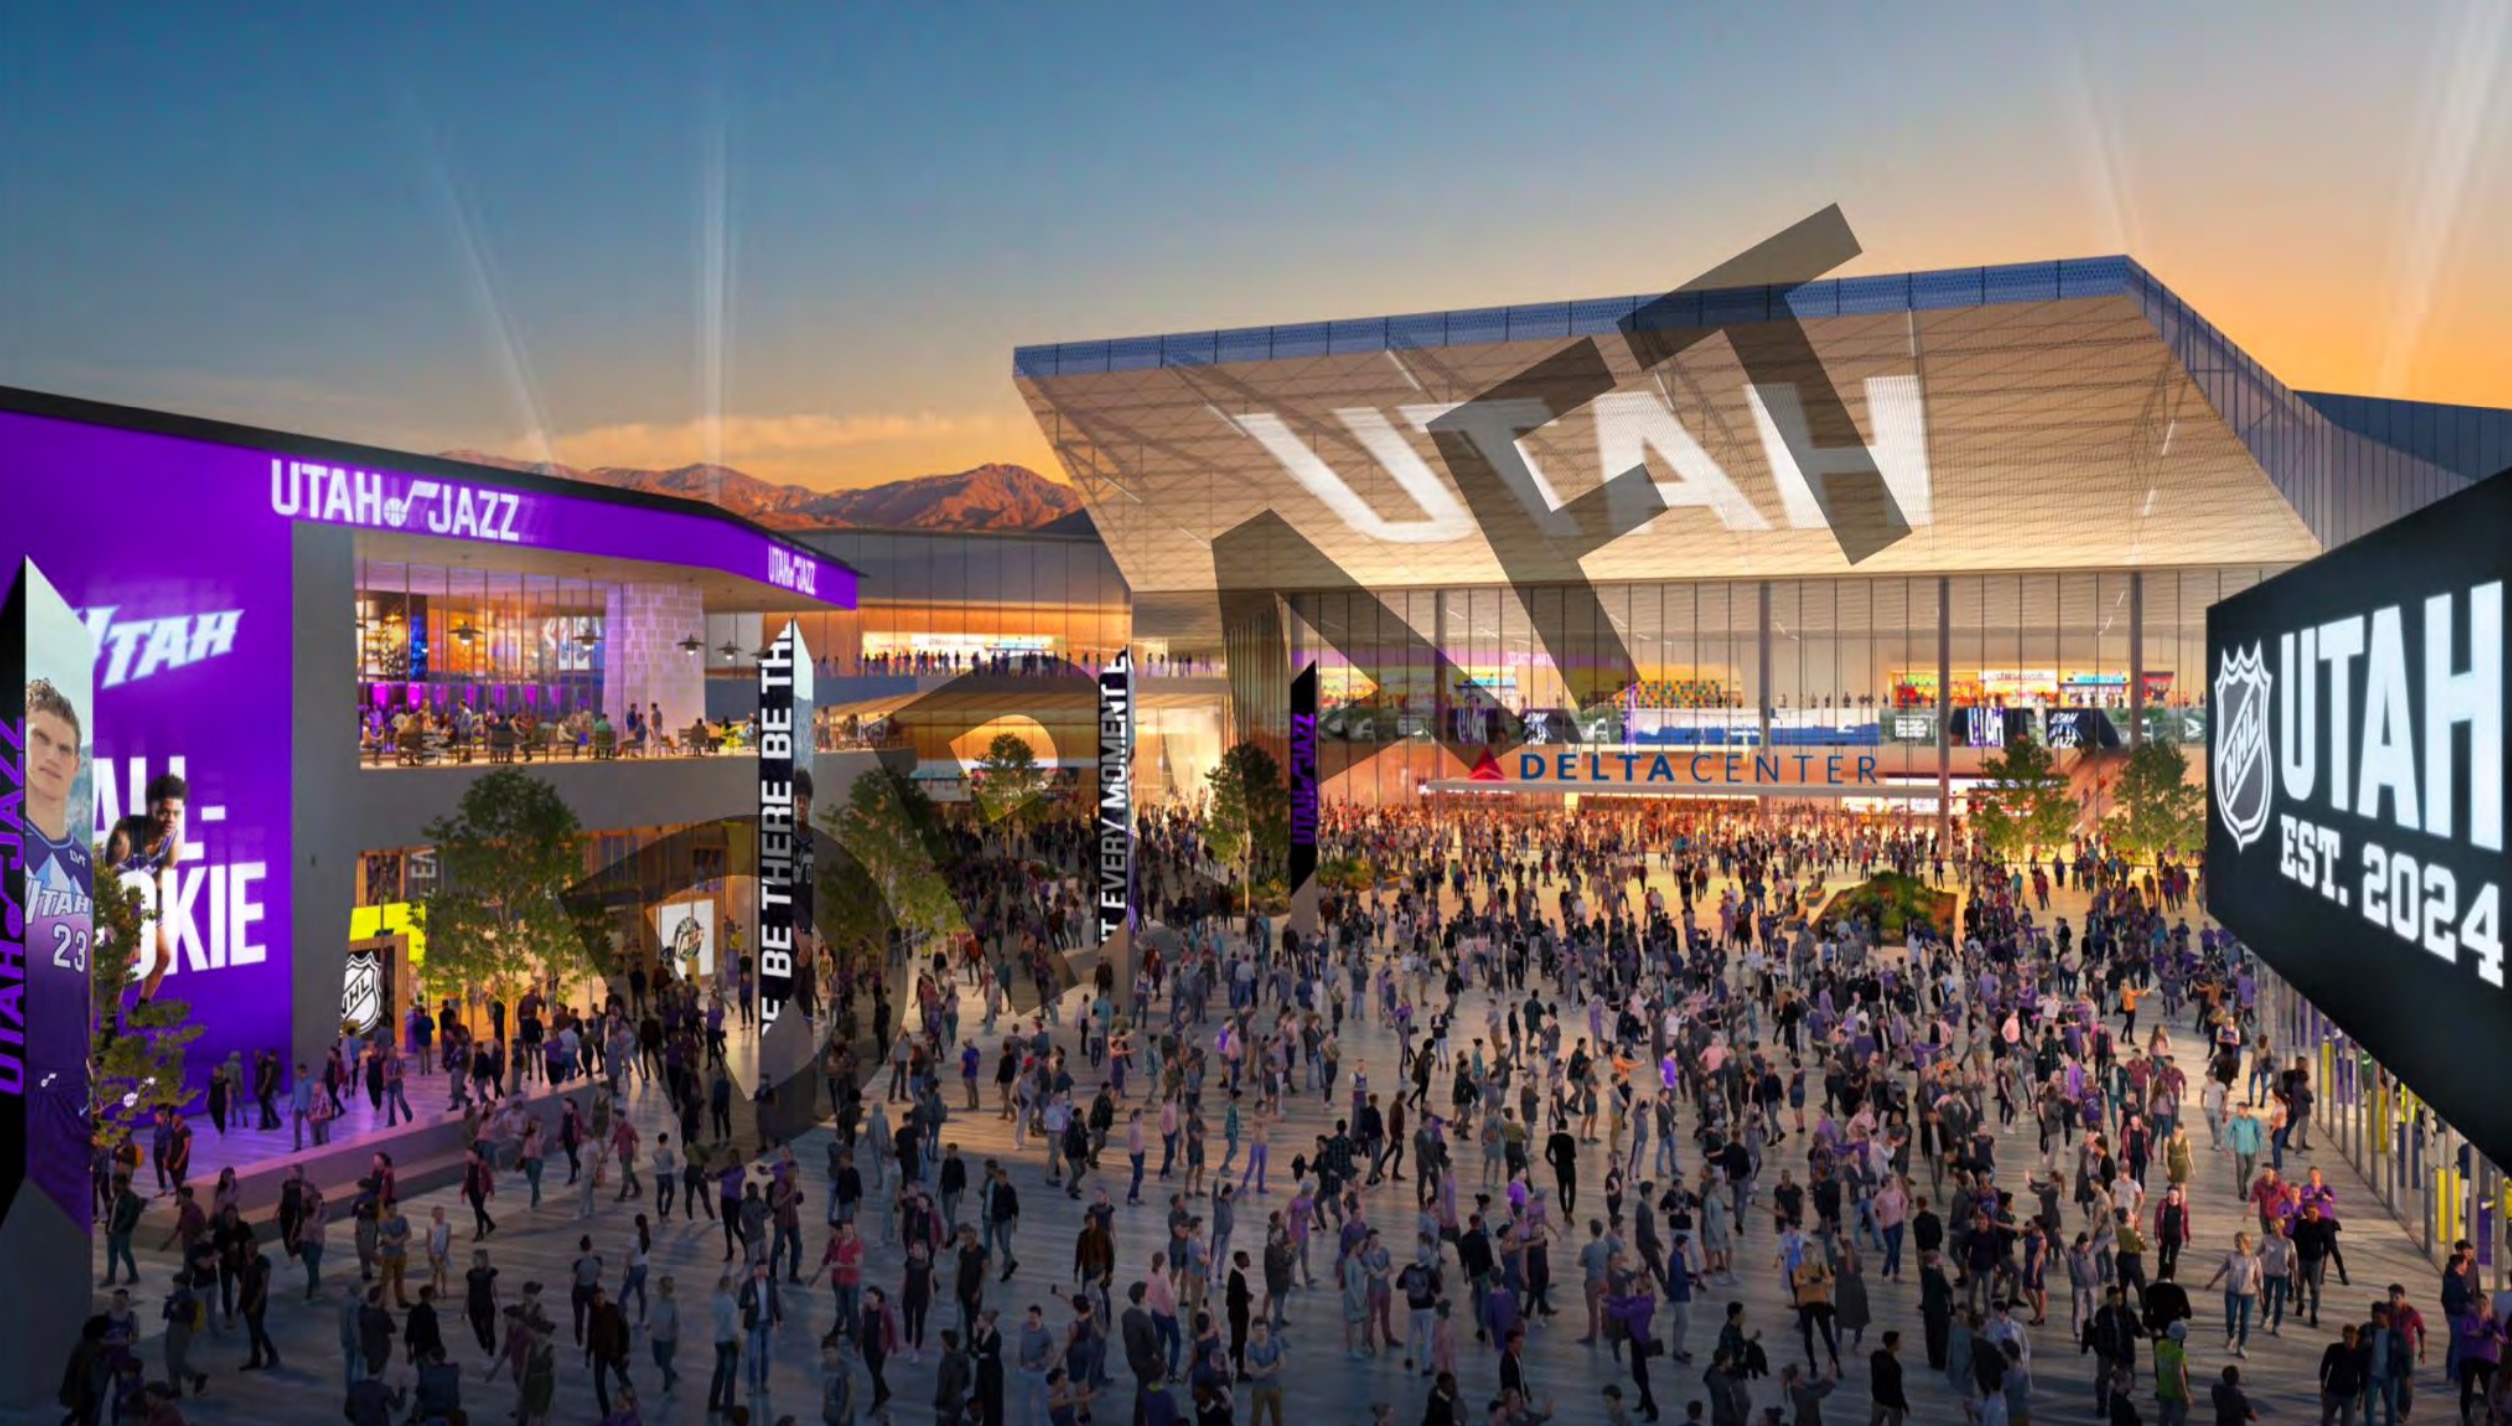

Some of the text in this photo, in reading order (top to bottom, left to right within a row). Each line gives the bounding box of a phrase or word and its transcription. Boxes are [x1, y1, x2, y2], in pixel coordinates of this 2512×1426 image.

[272, 459, 520, 542] UTAH JAZZ
[1233, 375, 1933, 543] UTAH
[768, 544, 816, 595] UTAH JAZZ
[762, 708, 792, 759] BE
[1101, 684, 1126, 808] MOMENT
[2224, 701, 2260, 796] NHL
[2281, 580, 2503, 853] UTAH
[1292, 713, 1315, 844] UTAH JAZZ
[1520, 753, 1878, 784] DELTA CENTER
[762, 781, 792, 910] THERE
[1101, 816, 1126, 908] EVERY
[0, 716, 24, 1095] UTAH JAZZ
[53, 924, 87, 973] 23
[2281, 814, 2504, 988] EST. 2024
[762, 925, 792, 978] BE
